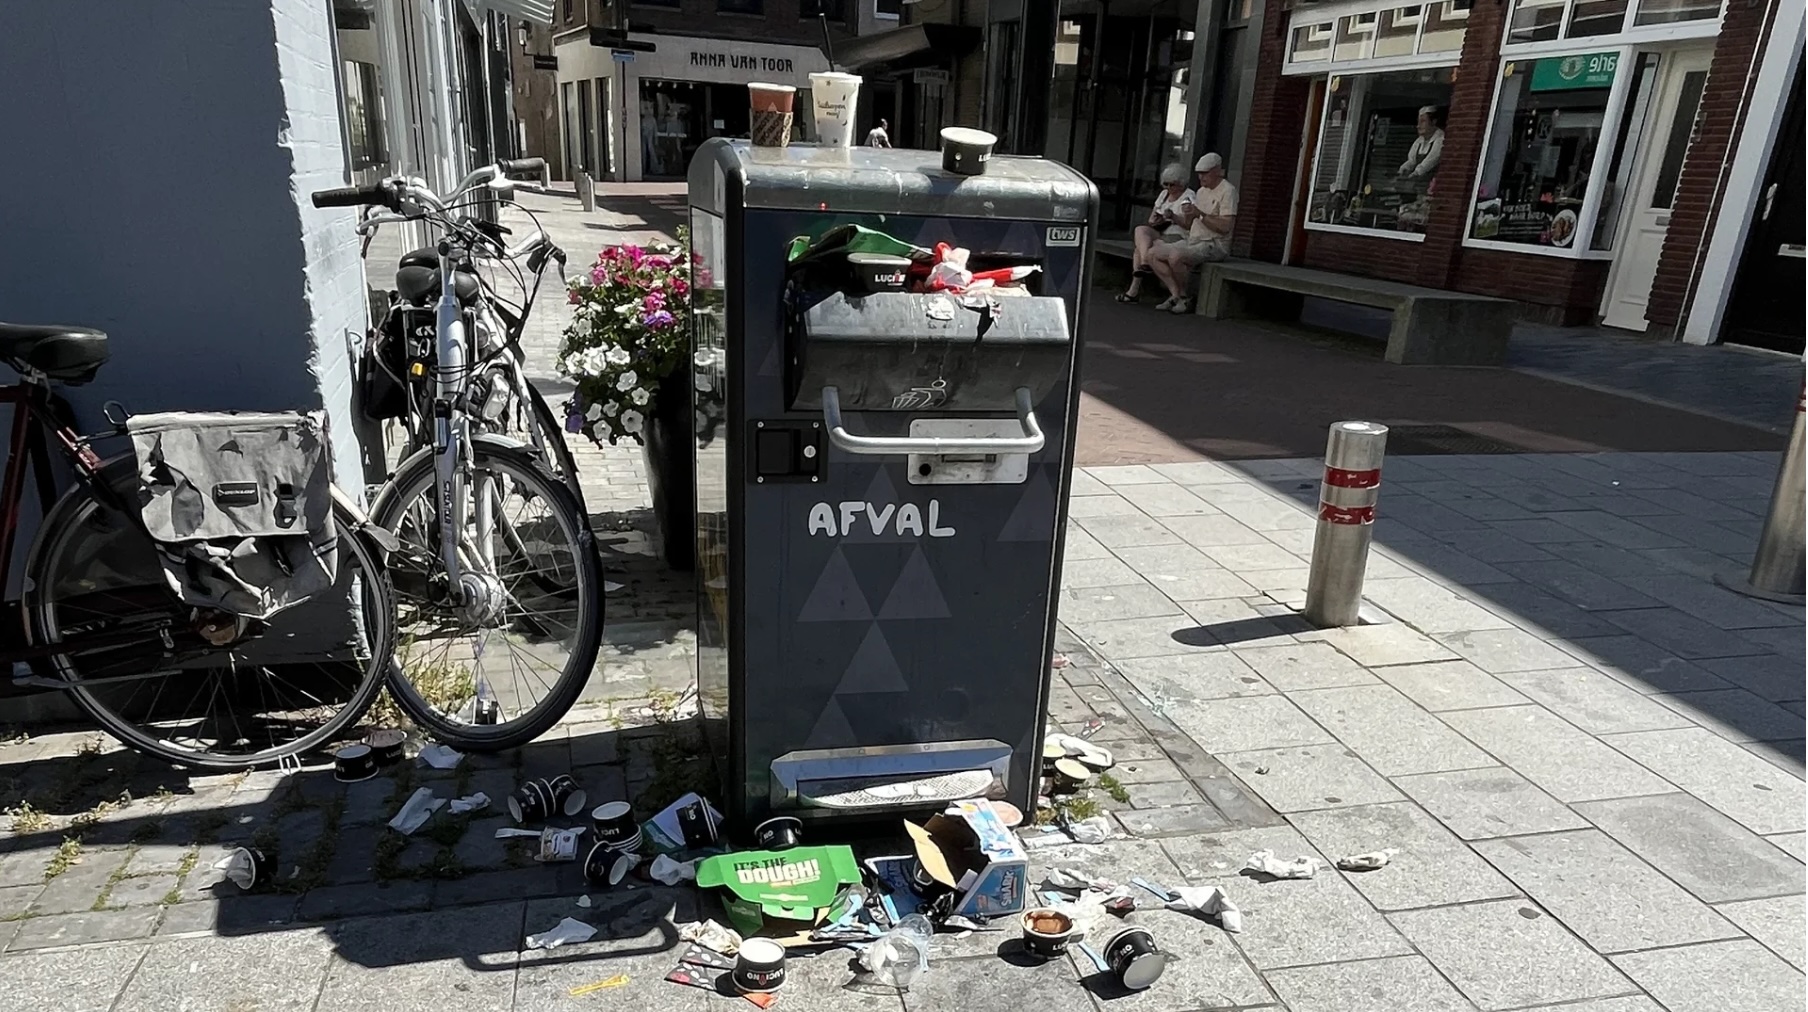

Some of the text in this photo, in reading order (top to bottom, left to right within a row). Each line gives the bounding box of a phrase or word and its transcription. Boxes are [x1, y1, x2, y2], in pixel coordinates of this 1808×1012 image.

[690, 52, 794, 72] ANNA VAN TOOR
[1051, 227, 1076, 240] tws
[808, 499, 956, 537] AFVAL
[733, 856, 788, 872] IT'S THE
[736, 858, 822, 885] DOUGH!
[1001, 869, 1015, 908] SHARK
